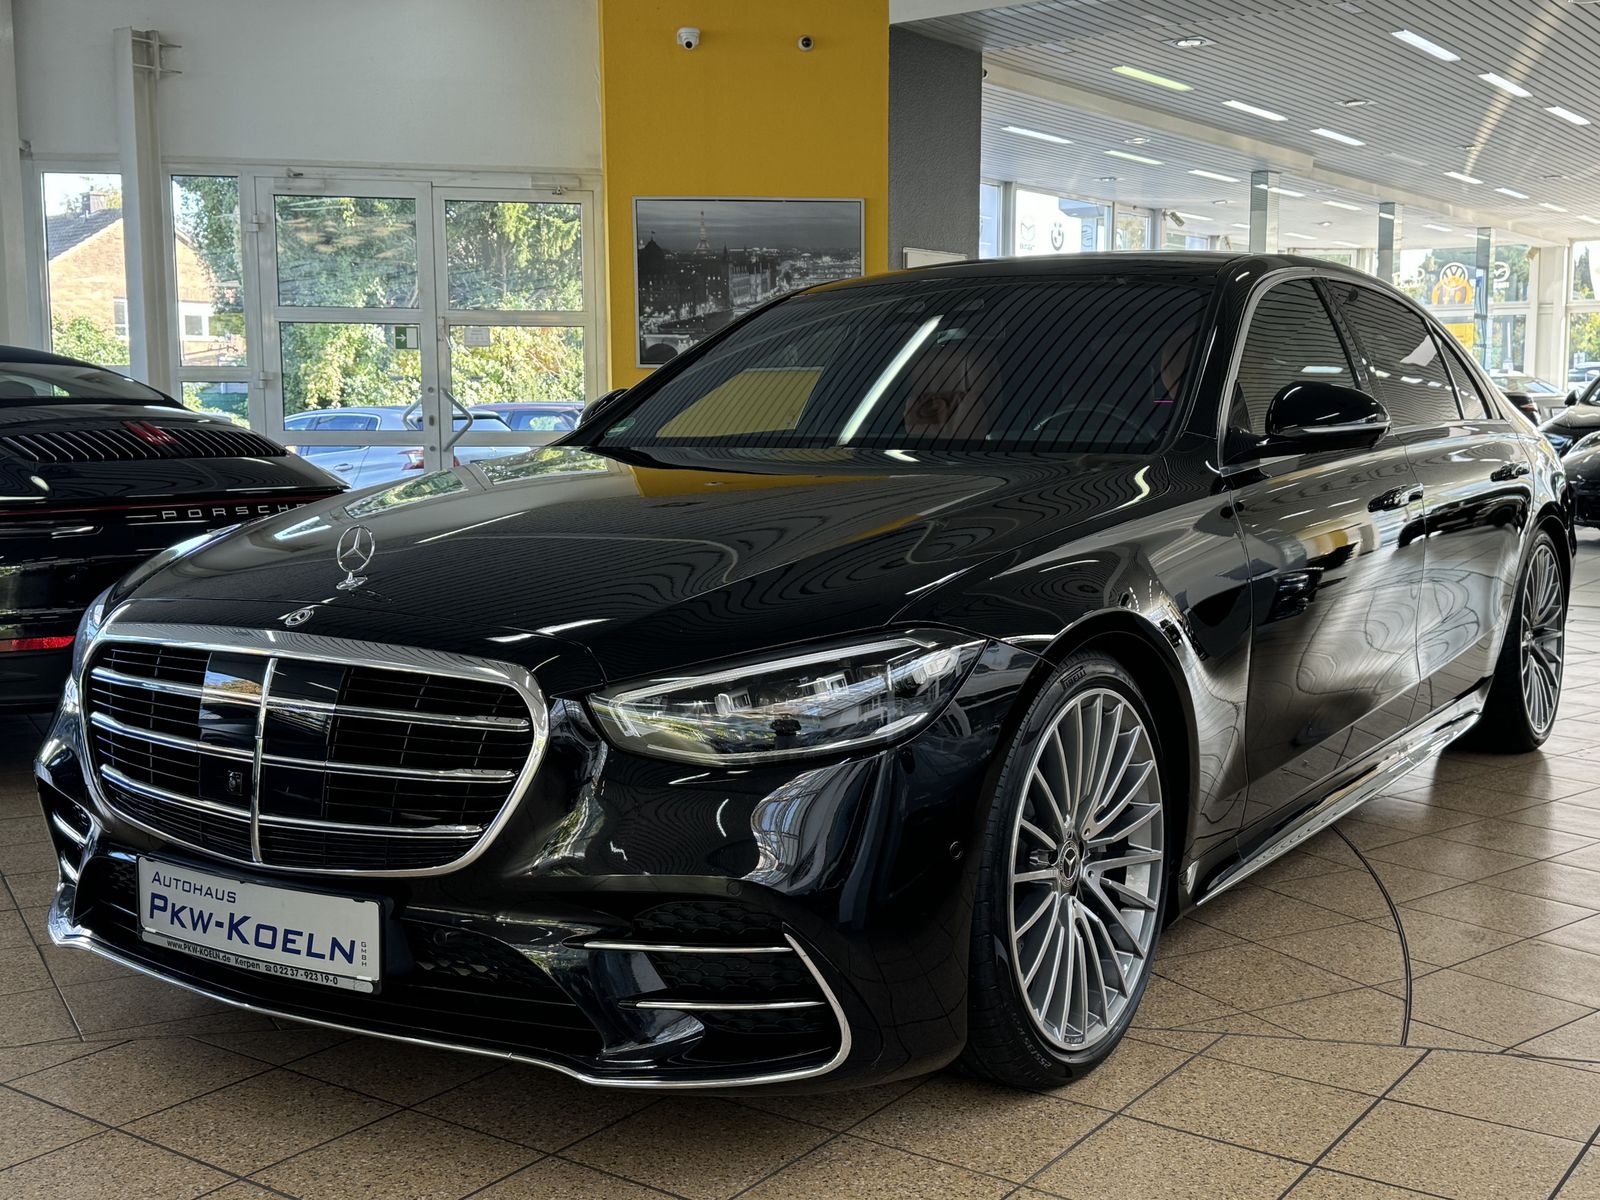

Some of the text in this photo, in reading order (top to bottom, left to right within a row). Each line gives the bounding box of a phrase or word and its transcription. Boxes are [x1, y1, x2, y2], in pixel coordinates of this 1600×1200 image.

[151, 871, 237, 903] AUTOHAUS
[149, 892, 356, 964] PKW-KOELN
[166, 939, 231, 963] www.PKW-KOELN.de
[234, 956, 260, 970] Kerpen
